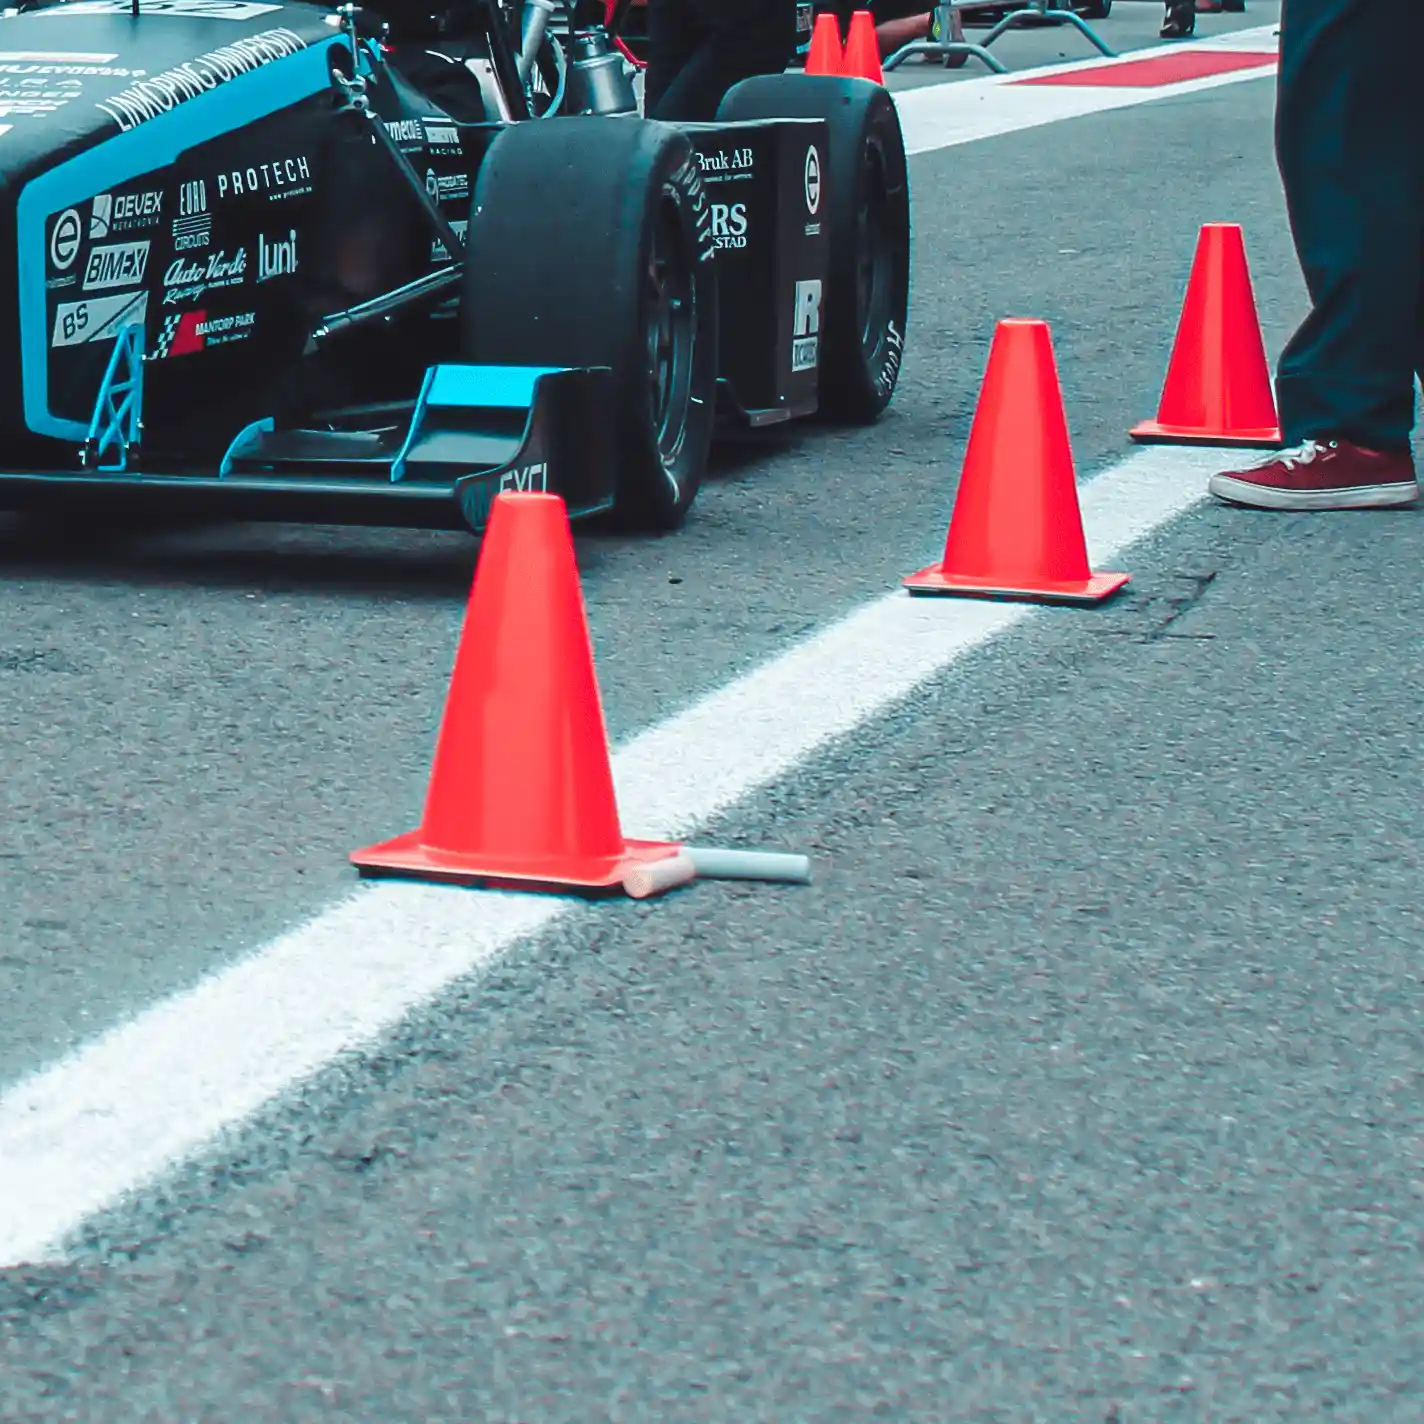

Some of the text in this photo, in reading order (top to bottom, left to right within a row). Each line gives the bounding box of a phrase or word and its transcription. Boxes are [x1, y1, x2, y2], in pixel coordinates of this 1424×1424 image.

[732, 148, 753, 168] AB
[218, 156, 310, 198] PROTECH
[114, 191, 164, 219] DEVEX
[175, 231, 210, 251] CIRCUITS
[713, 236, 747, 249] STAD
[86, 247, 145, 283] BIMEX
[63, 302, 89, 340] BS
[195, 312, 255, 335] MANTORP PARK
